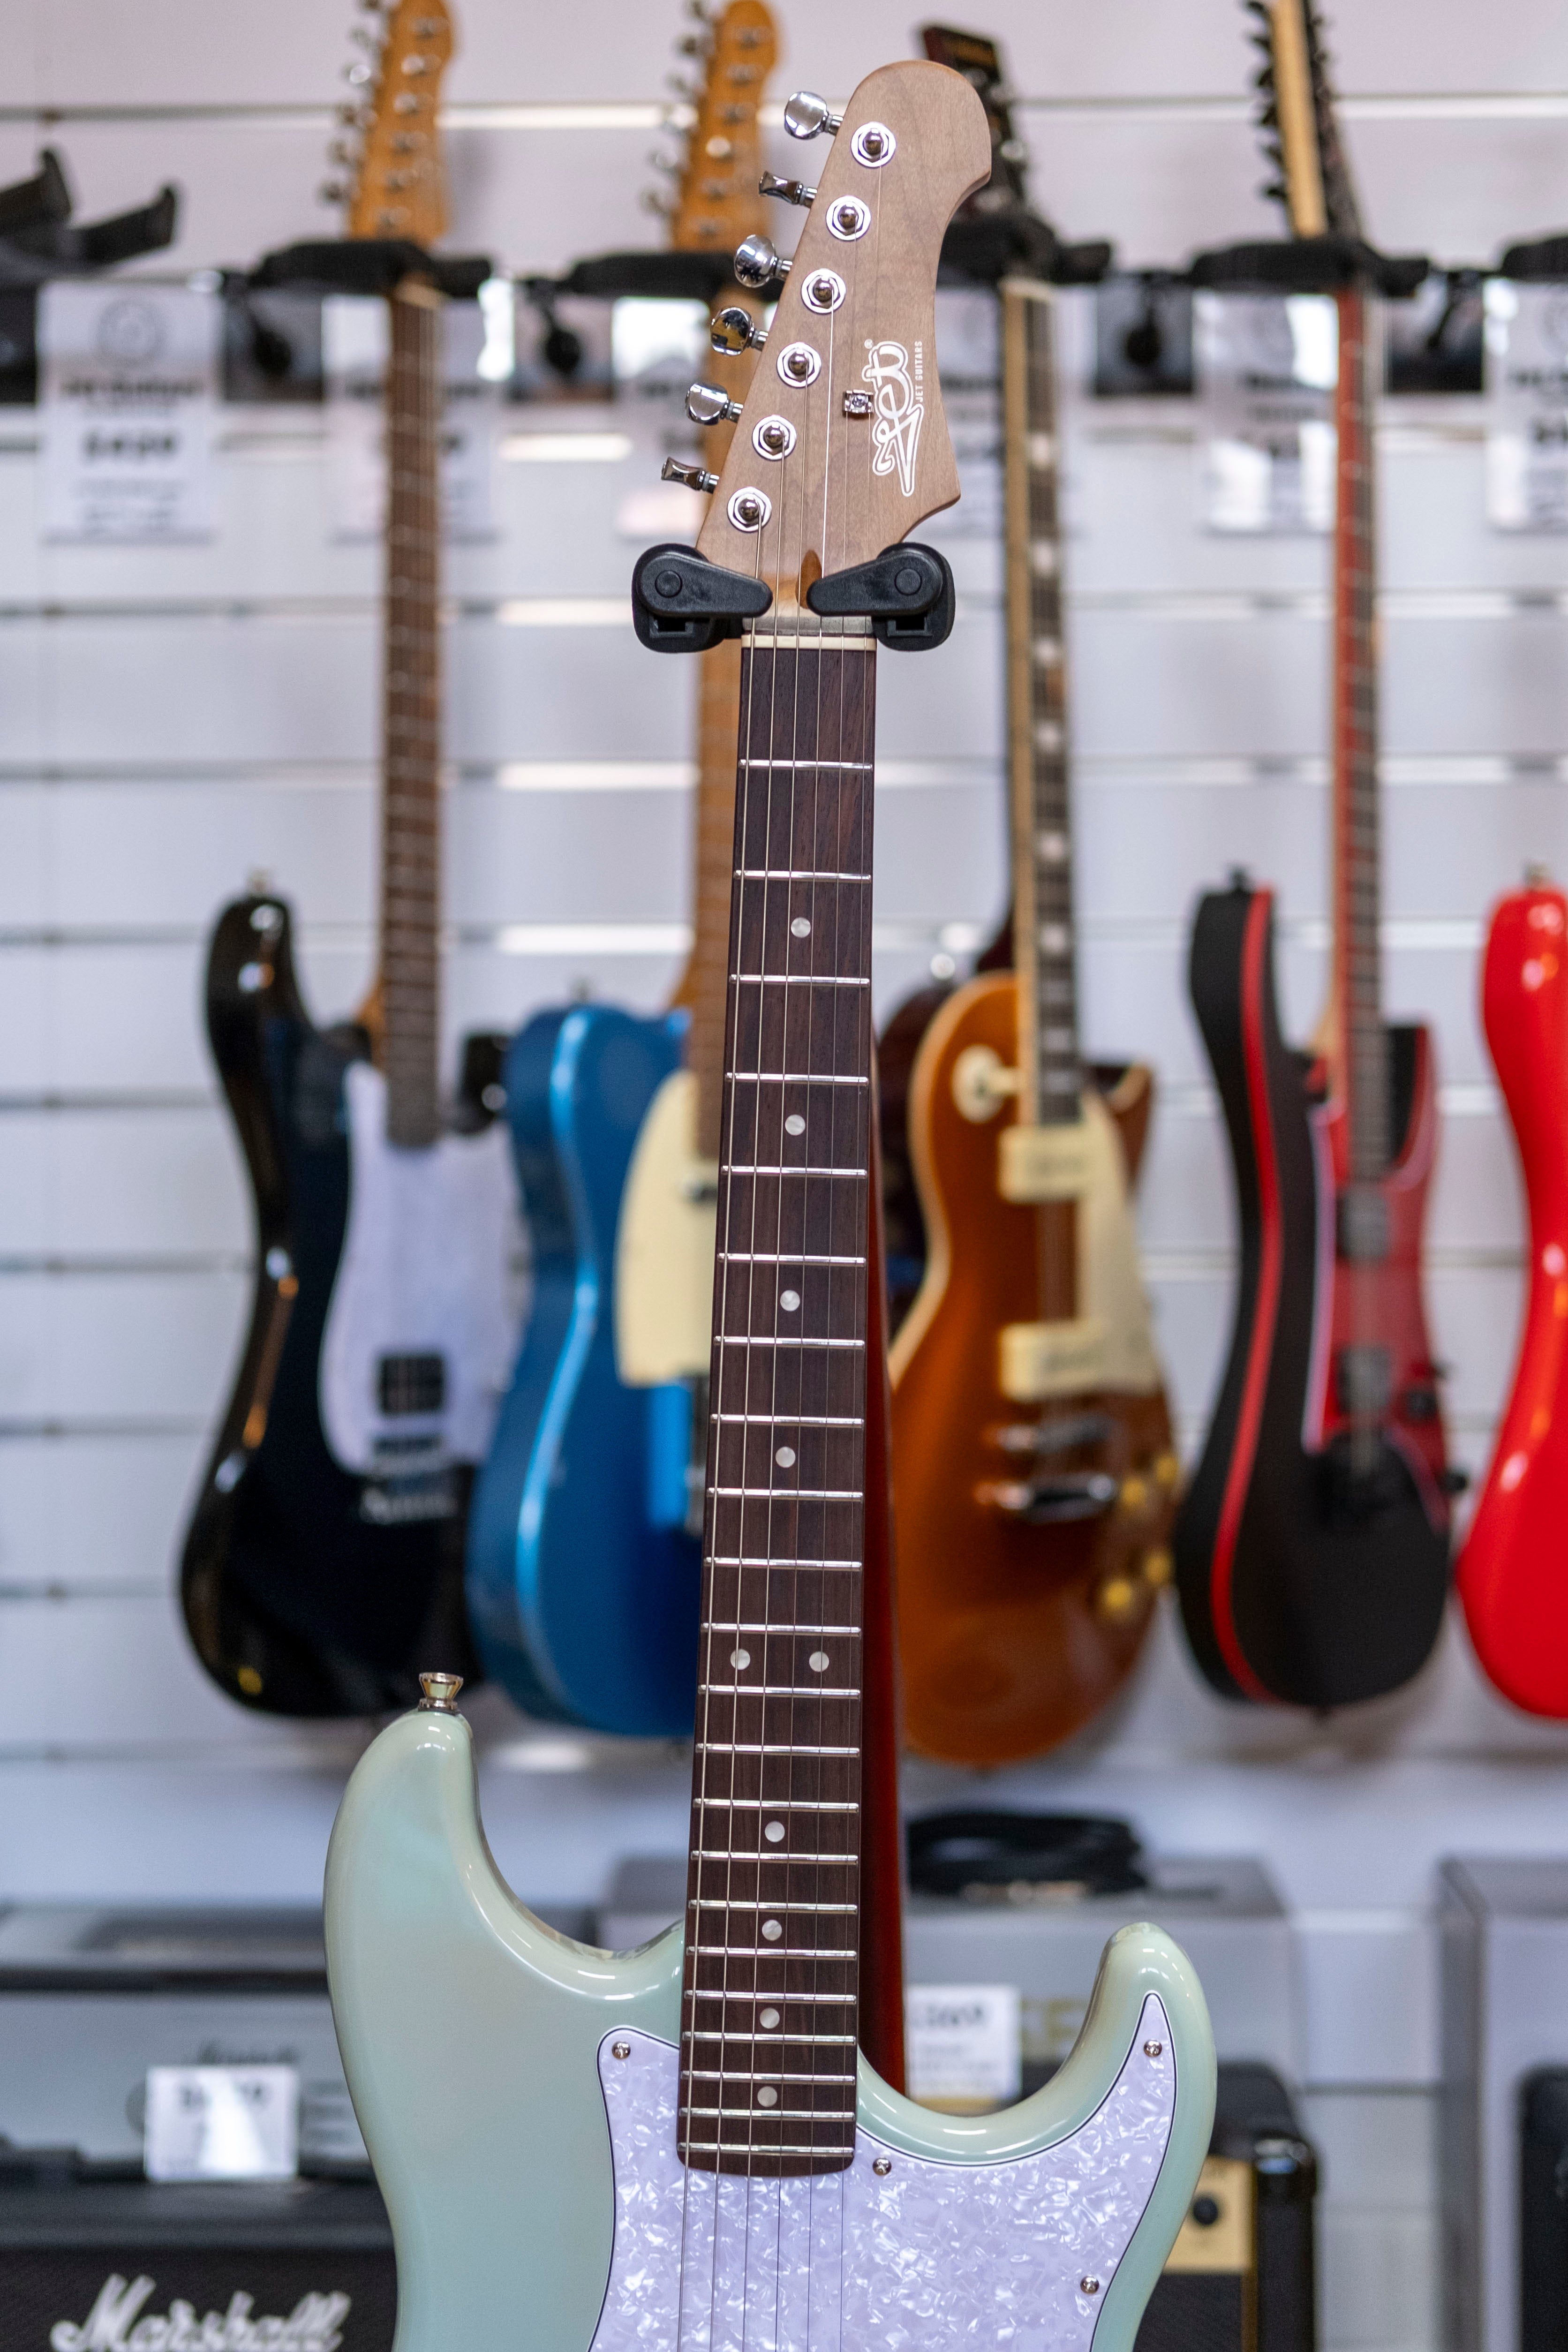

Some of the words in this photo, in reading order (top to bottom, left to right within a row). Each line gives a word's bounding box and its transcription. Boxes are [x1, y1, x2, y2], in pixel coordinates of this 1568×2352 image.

[914, 341, 923, 381] GUITARS
[915, 384, 923, 402] JET
[50, 2273, 351, 2352] Marshall
